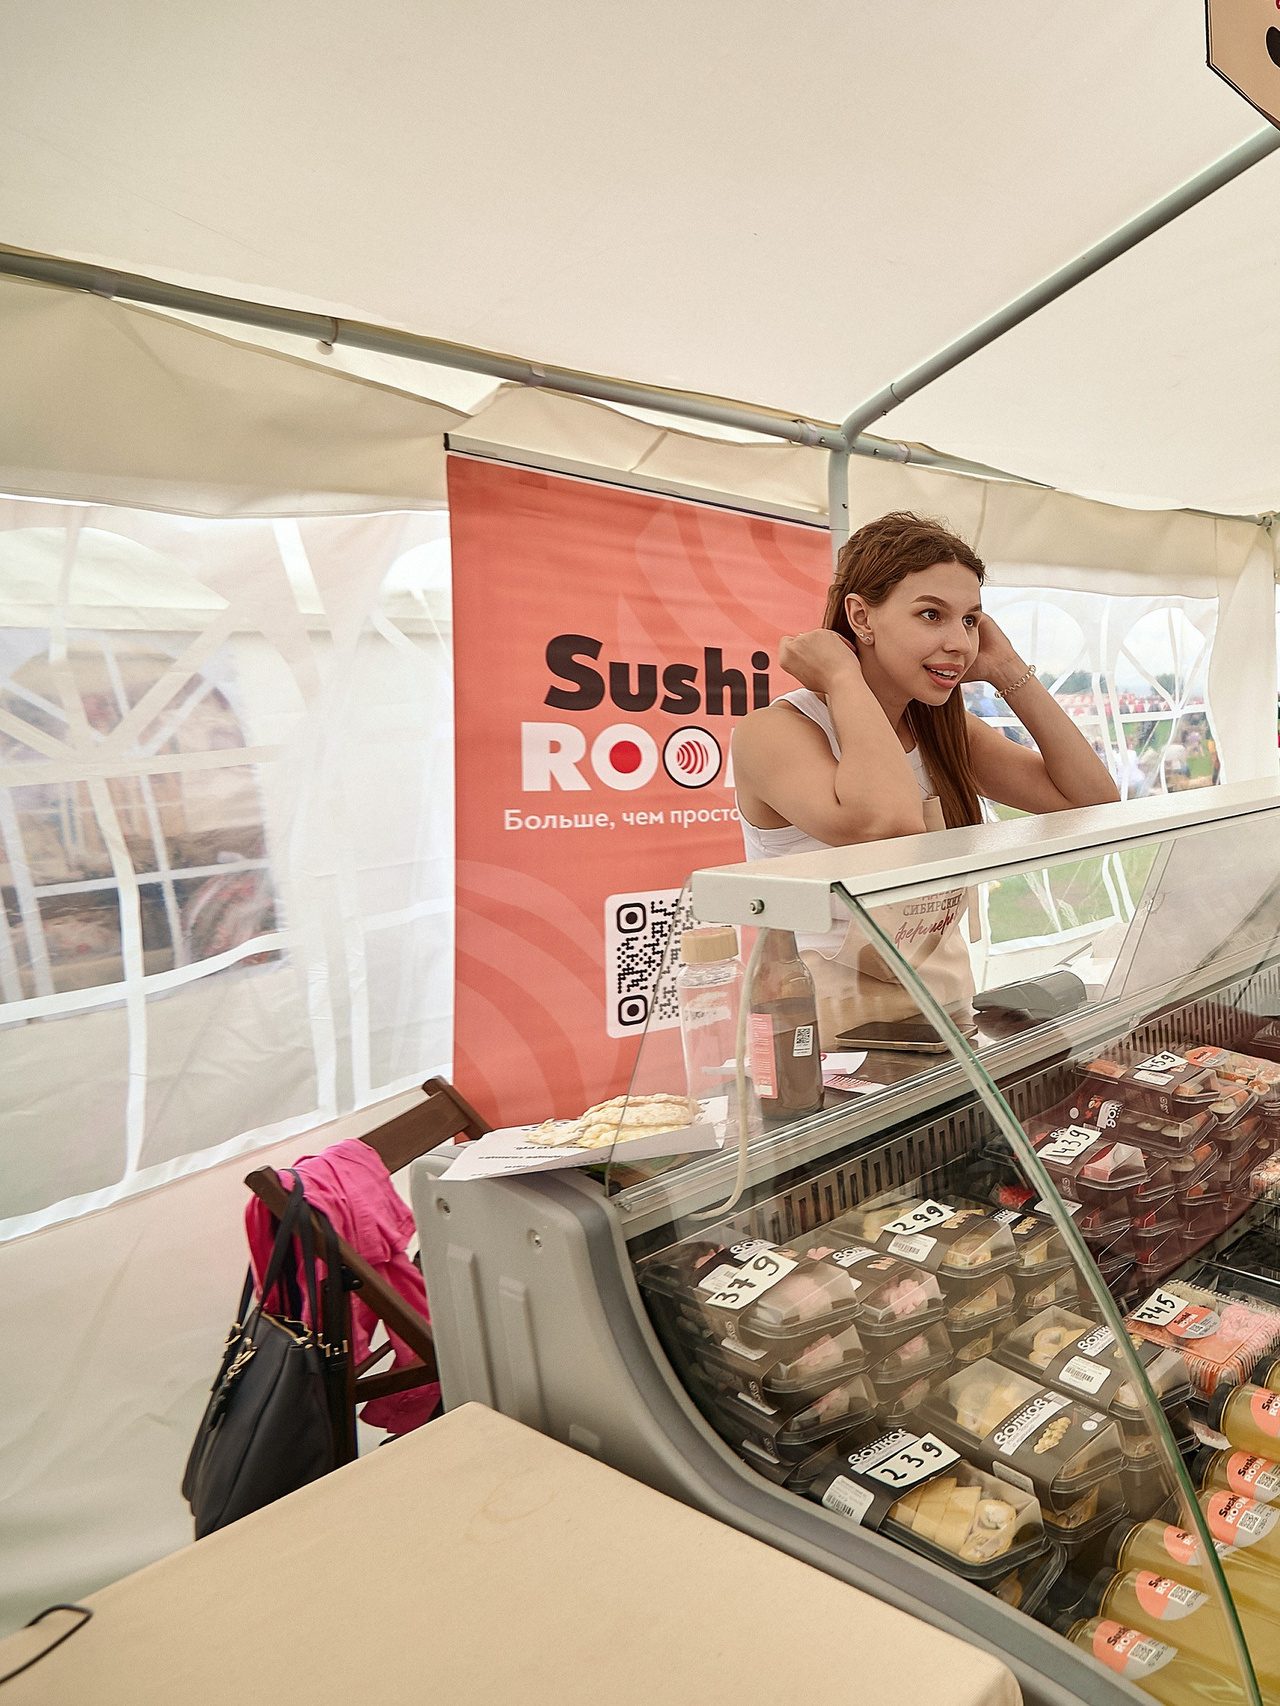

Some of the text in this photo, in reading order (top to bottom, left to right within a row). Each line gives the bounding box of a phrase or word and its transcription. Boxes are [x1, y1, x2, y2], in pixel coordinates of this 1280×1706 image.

[544, 634, 770, 717] Sushi
[521, 721, 737, 792] ROO
[503, 808, 740, 831] Больше, чем просто
[1141, 1054, 1176, 1069] 459
[1052, 1129, 1091, 1154] 439
[892, 1205, 944, 1231] 299
[714, 1255, 780, 1304] 379
[1136, 1293, 1176, 1320] 745
[880, 1441, 942, 1481] 239
[1237, 1455, 1258, 1477] Sushi
[1243, 1457, 1268, 1482] ROOM
[1218, 1494, 1241, 1518] Sushi
[1225, 1496, 1251, 1524] ROOM
